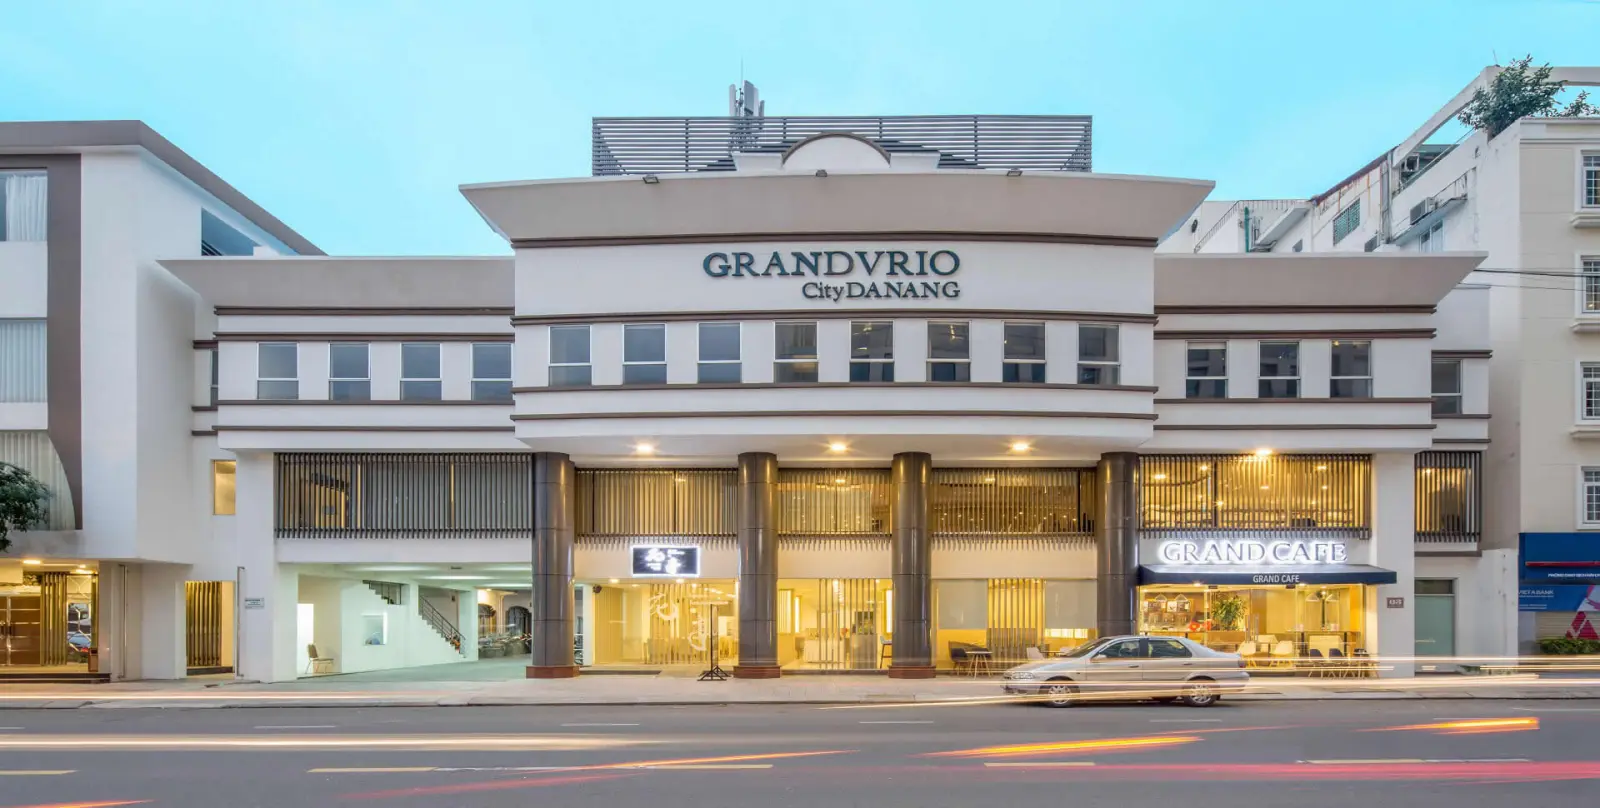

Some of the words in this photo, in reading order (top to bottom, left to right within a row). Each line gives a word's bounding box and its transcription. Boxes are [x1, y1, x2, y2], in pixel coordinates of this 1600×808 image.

[702, 250, 960, 277] GRANDVRIO
[802, 282, 844, 302] City
[846, 281, 960, 298] DANANG
[1162, 542, 1265, 562] GRAND
[1272, 542, 1348, 562] CAFE
[1253, 574, 1279, 583] GRAND
[1281, 574, 1300, 583] CAFE
